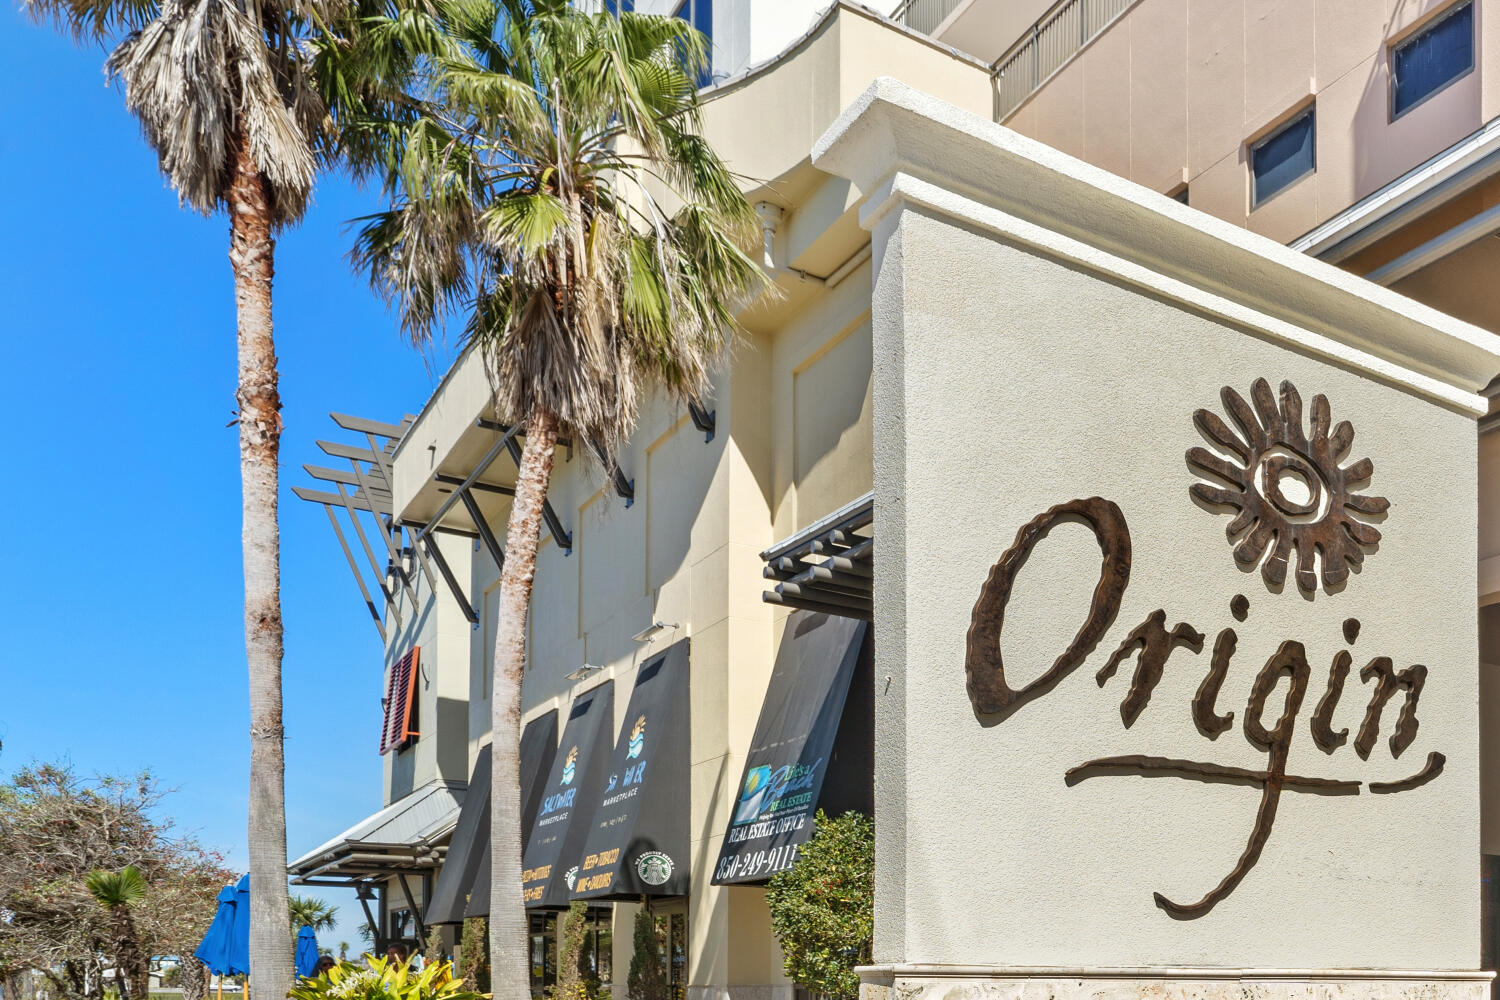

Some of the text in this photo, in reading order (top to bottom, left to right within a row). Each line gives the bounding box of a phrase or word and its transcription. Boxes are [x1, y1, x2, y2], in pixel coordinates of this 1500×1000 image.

[965, 496, 1446, 921] Origin
[602, 787, 638, 807] MARKETPLACE
[760, 757, 822, 814] Beach
[769, 798, 788, 813] REAL
[787, 791, 813, 808] ESTATE
[539, 812, 569, 827] MARKETPLACE
[728, 812, 806, 844] REAL ESTATE OFFICE
[716, 843, 798, 880] 850-249-9111
